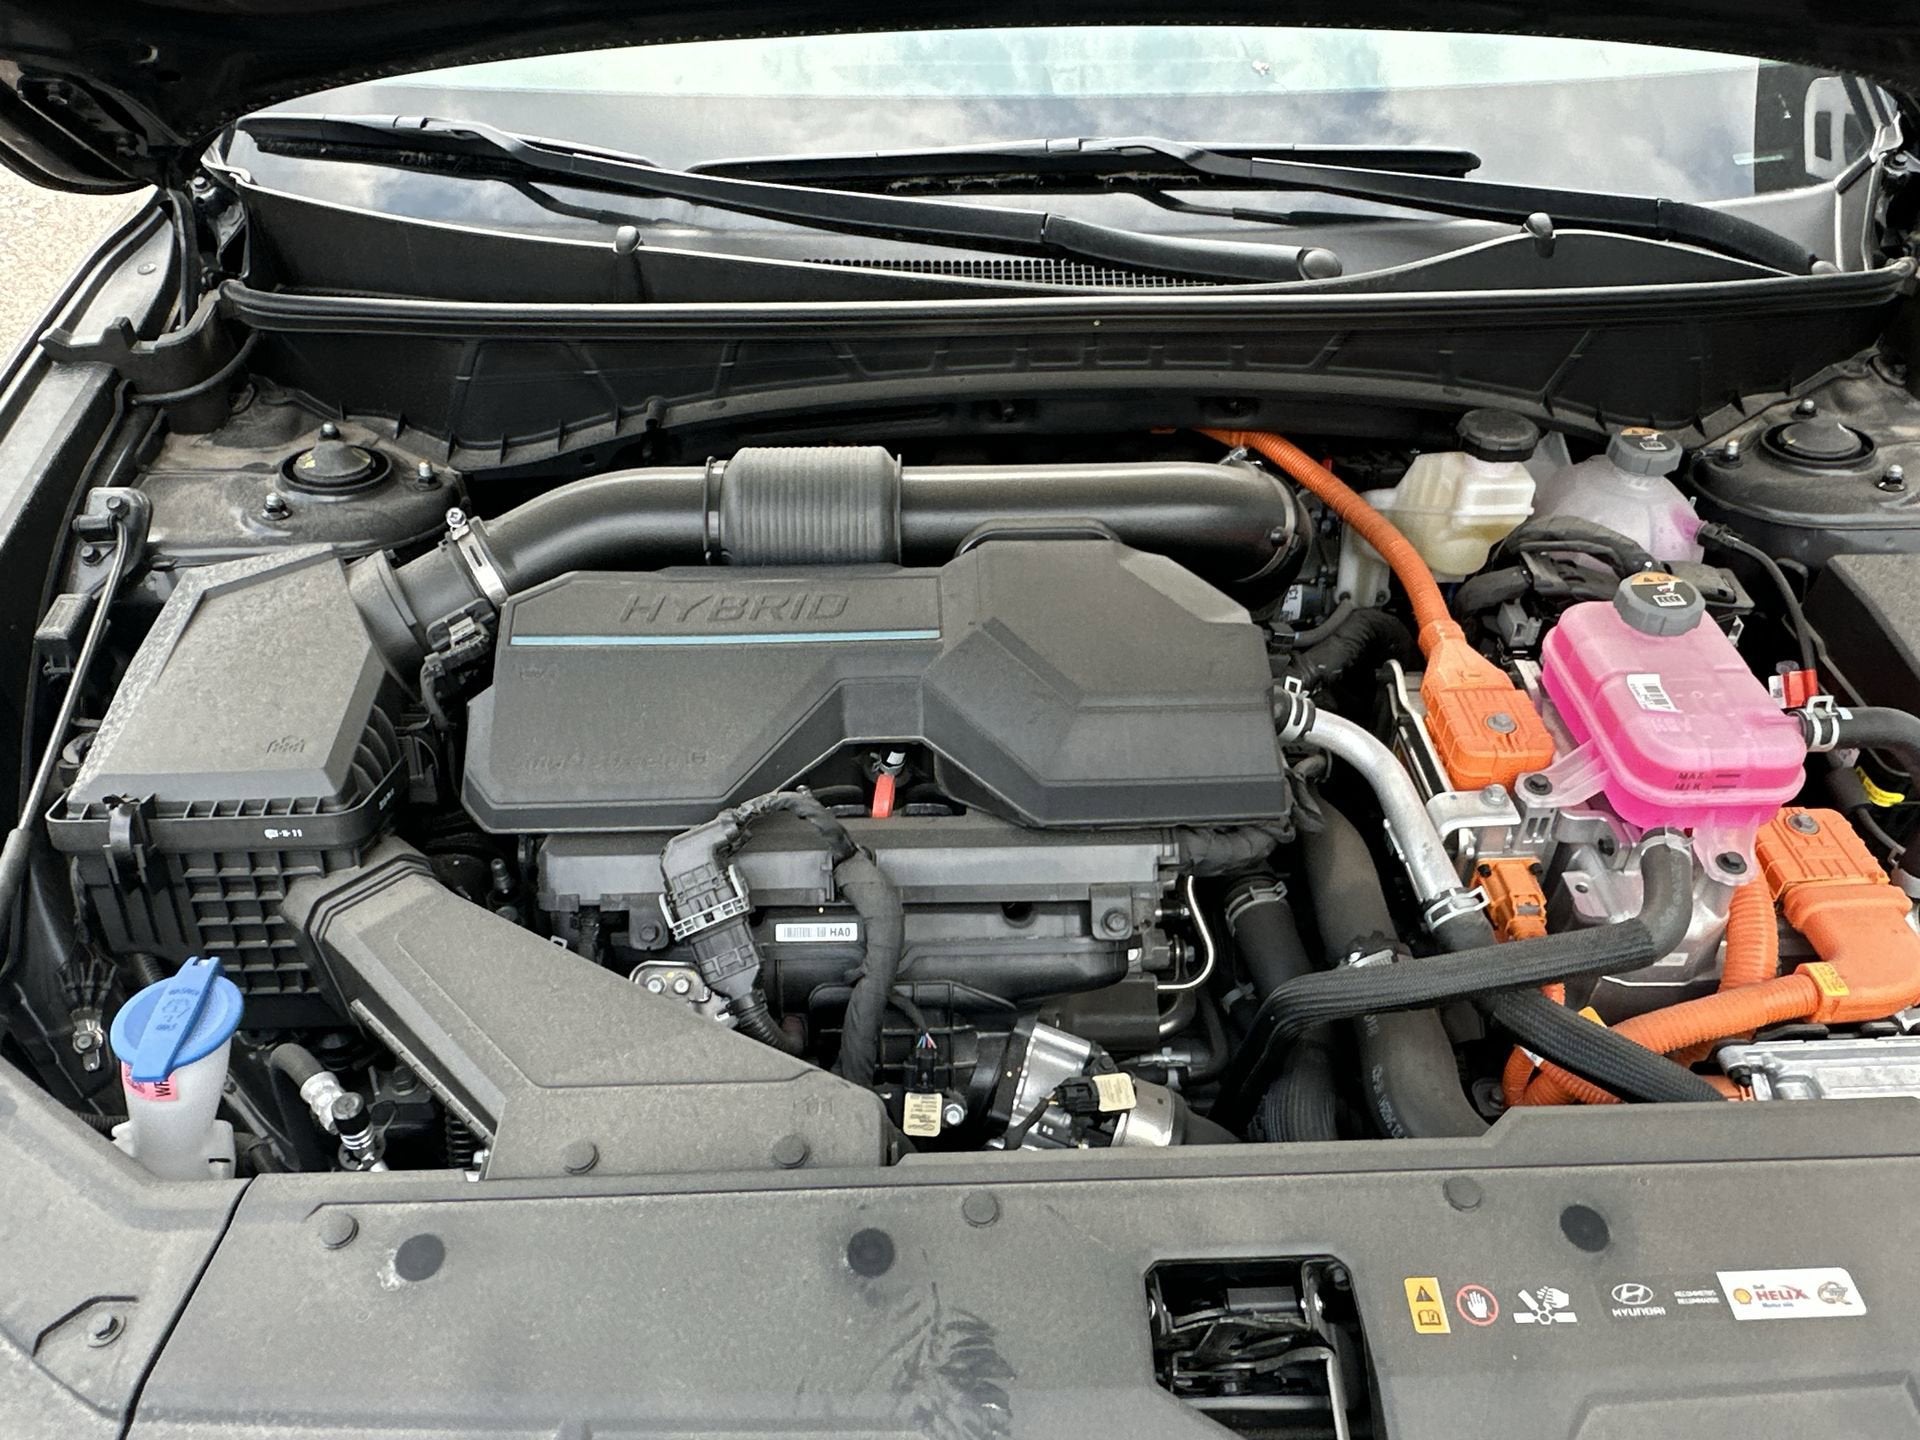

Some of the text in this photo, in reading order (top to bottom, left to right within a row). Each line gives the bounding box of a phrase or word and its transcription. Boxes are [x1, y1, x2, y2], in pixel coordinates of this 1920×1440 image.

[619, 593, 850, 624] HYBRID
[1755, 1285, 1811, 1301] HELIX
[1611, 1306, 1667, 1317] HYUNDAI
